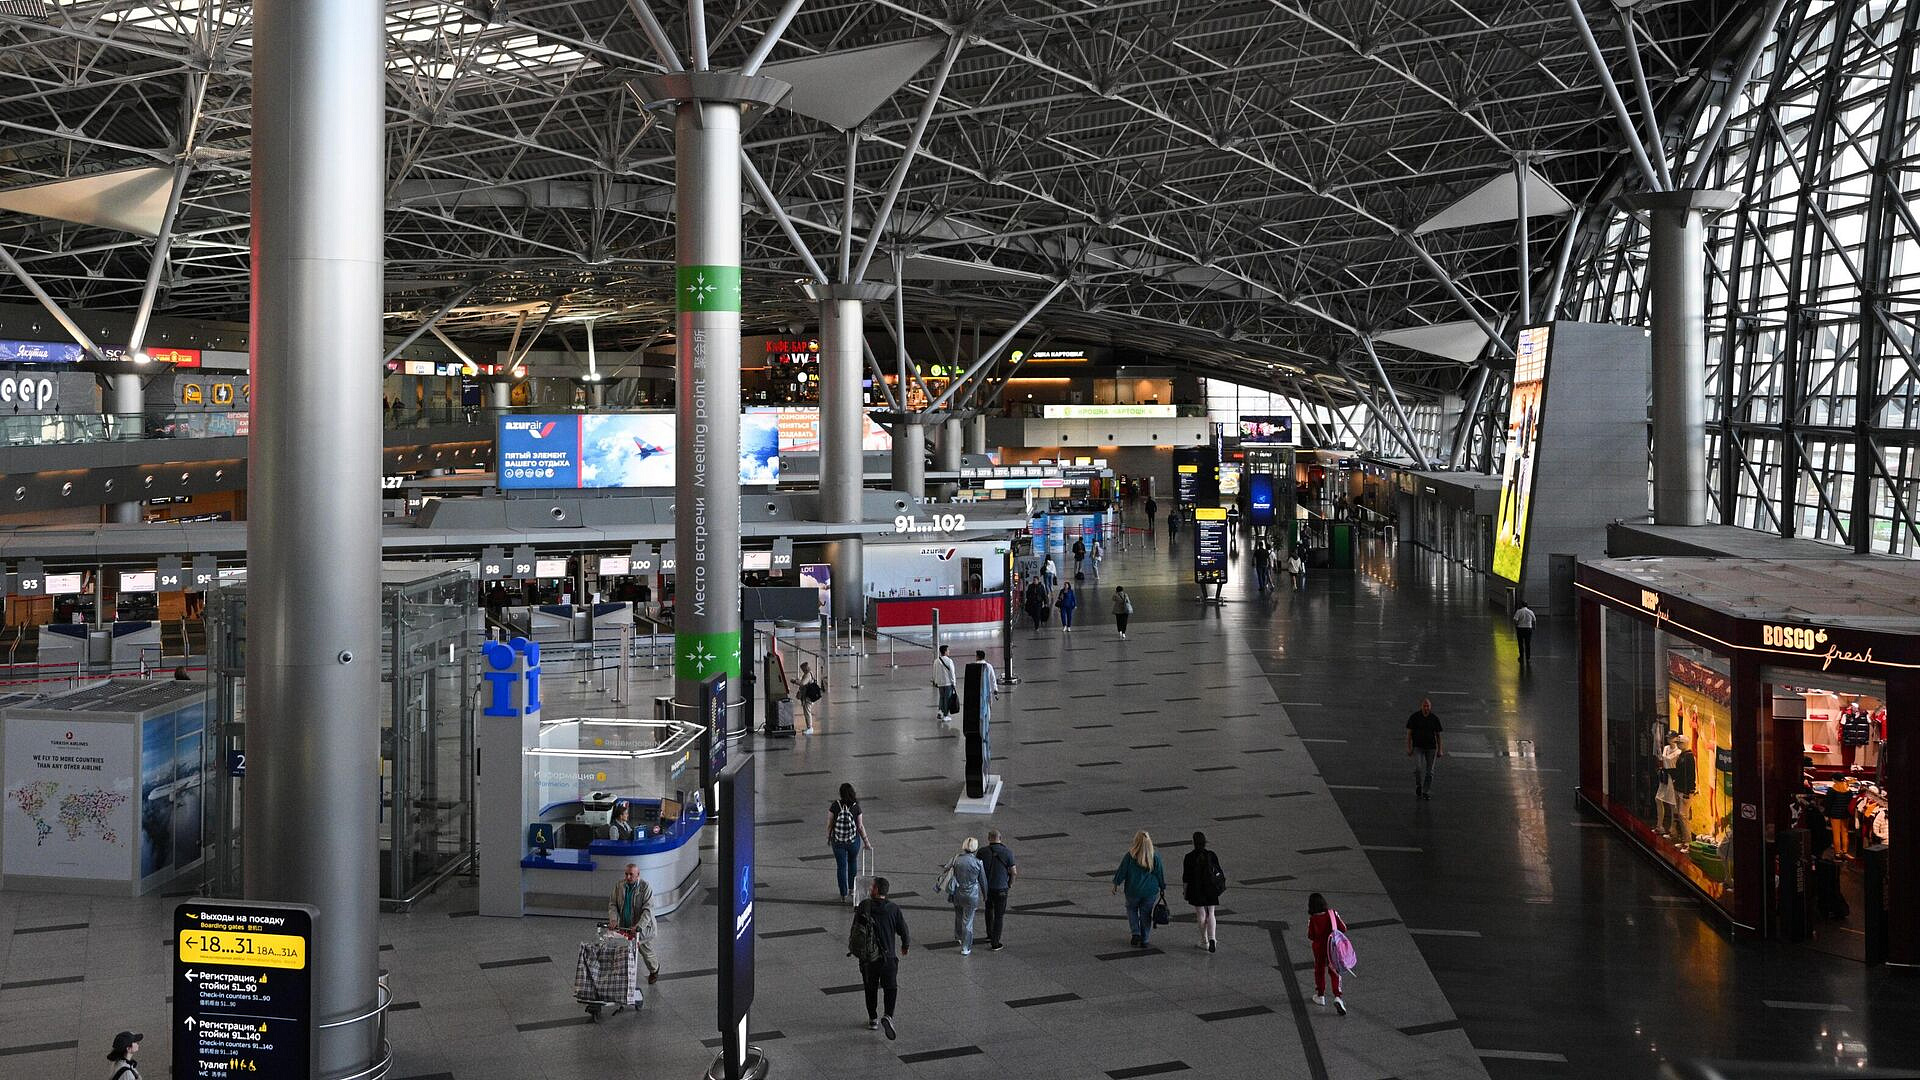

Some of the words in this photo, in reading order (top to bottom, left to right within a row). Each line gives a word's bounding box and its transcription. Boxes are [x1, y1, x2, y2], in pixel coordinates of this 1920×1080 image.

[693, 378, 708, 419] point
[505, 451, 531, 459] ПЯТЫЙ
[693, 423, 709, 488] Meeting
[895, 514, 966, 533] 91...102
[695, 497, 708, 561] встречи
[774, 555, 791, 563] 102
[486, 565, 500, 574] 98
[517, 564, 530, 573] 99
[632, 560, 650, 570] 100
[161, 576, 178, 585] 94
[197, 574, 212, 584] 95
[22, 580, 38, 589] 93
[693, 566, 705, 616] Место
[1763, 624, 1815, 651] BOSCO
[1822, 644, 1873, 671] fresh
[76, 756, 104, 764] COUNTRIES
[236, 754, 245, 769] 2
[200, 912, 235, 922] Выходы
[249, 917, 285, 926] посадку
[200, 922, 227, 931] Boarding
[200, 935, 254, 955] 18...31
[257, 946, 298, 958] 18A...31A
[199, 971, 257, 984] Регистрация,
[199, 982, 230, 991] стойки
[199, 991, 225, 999] Check-in
[225, 993, 251, 1001] counters
[199, 1020, 257, 1033] Регистрация,
[199, 1030, 230, 1039] стойки
[199, 1039, 225, 1047] Check-in
[225, 1041, 251, 1049] counters
[198, 1060, 229, 1070] Туалет
